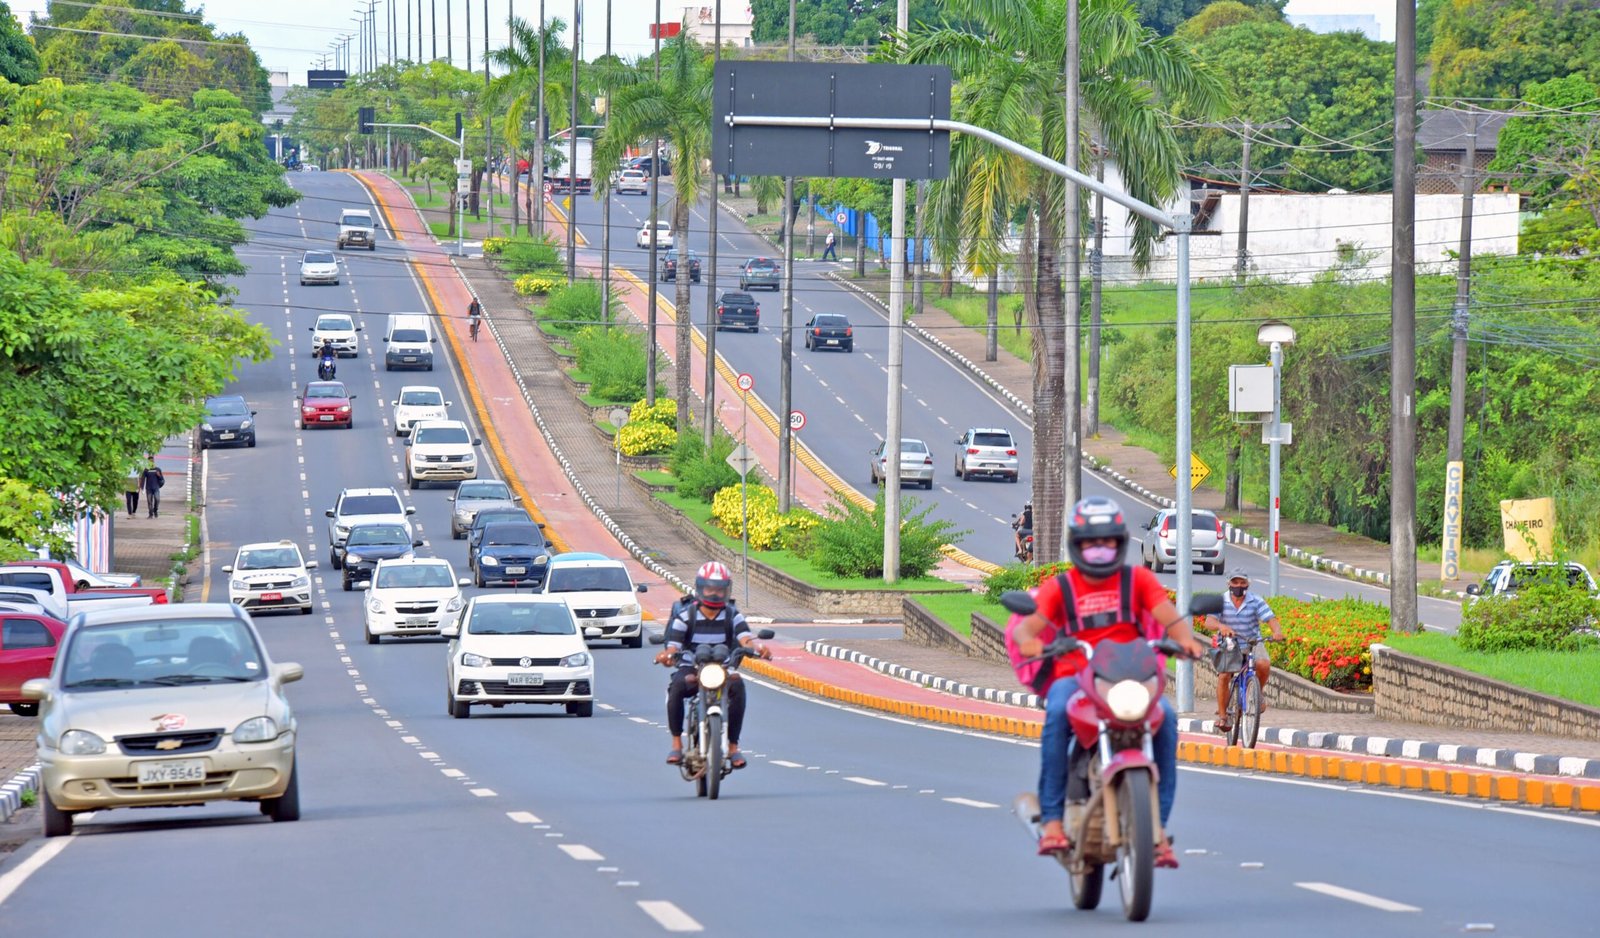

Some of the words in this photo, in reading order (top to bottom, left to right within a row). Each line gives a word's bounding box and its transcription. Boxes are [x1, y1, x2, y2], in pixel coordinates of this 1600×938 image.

[791, 415, 802, 423] 50
[1445, 467, 1460, 578] CHAVEIRO
[143, 766, 202, 782] JXY-9545
